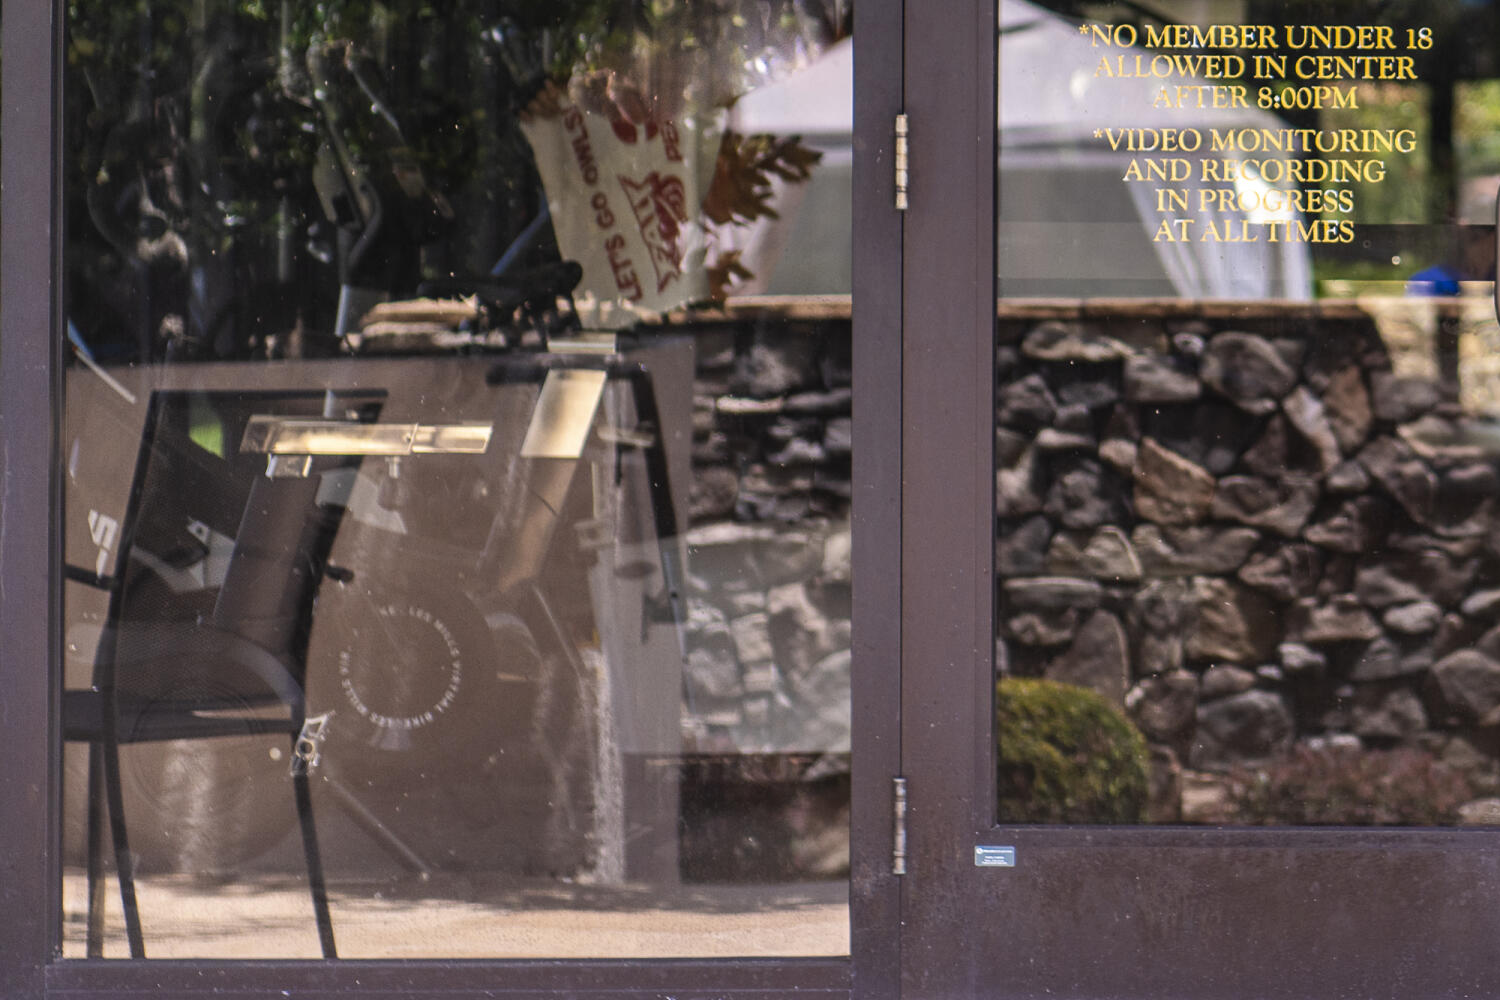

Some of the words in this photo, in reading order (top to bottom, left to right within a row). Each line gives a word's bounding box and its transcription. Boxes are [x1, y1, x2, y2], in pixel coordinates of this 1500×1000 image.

[1146, 25, 1278, 48] MEMBER
[1287, 26, 1396, 49] UNDER
[1406, 27, 1433, 49] 18
[1094, 55, 1245, 79] ALLOWED
[1253, 57, 1287, 79] IN
[1295, 57, 1418, 79] CENTER
[1153, 86, 1248, 109] AFTER
[1257, 86, 1359, 109] 8:00PM
[1211, 129, 1417, 153] MONITORING
[1122, 159, 1191, 182] AND
[1200, 159, 1386, 183] RECORDING
[591, 192, 615, 229] GO
[1156, 189, 1189, 212] IN
[1199, 189, 1354, 213] PROGRESS
[1154, 220, 1194, 243] AT
[1200, 220, 1261, 243] ALL
[1266, 220, 1355, 243] TIMES
